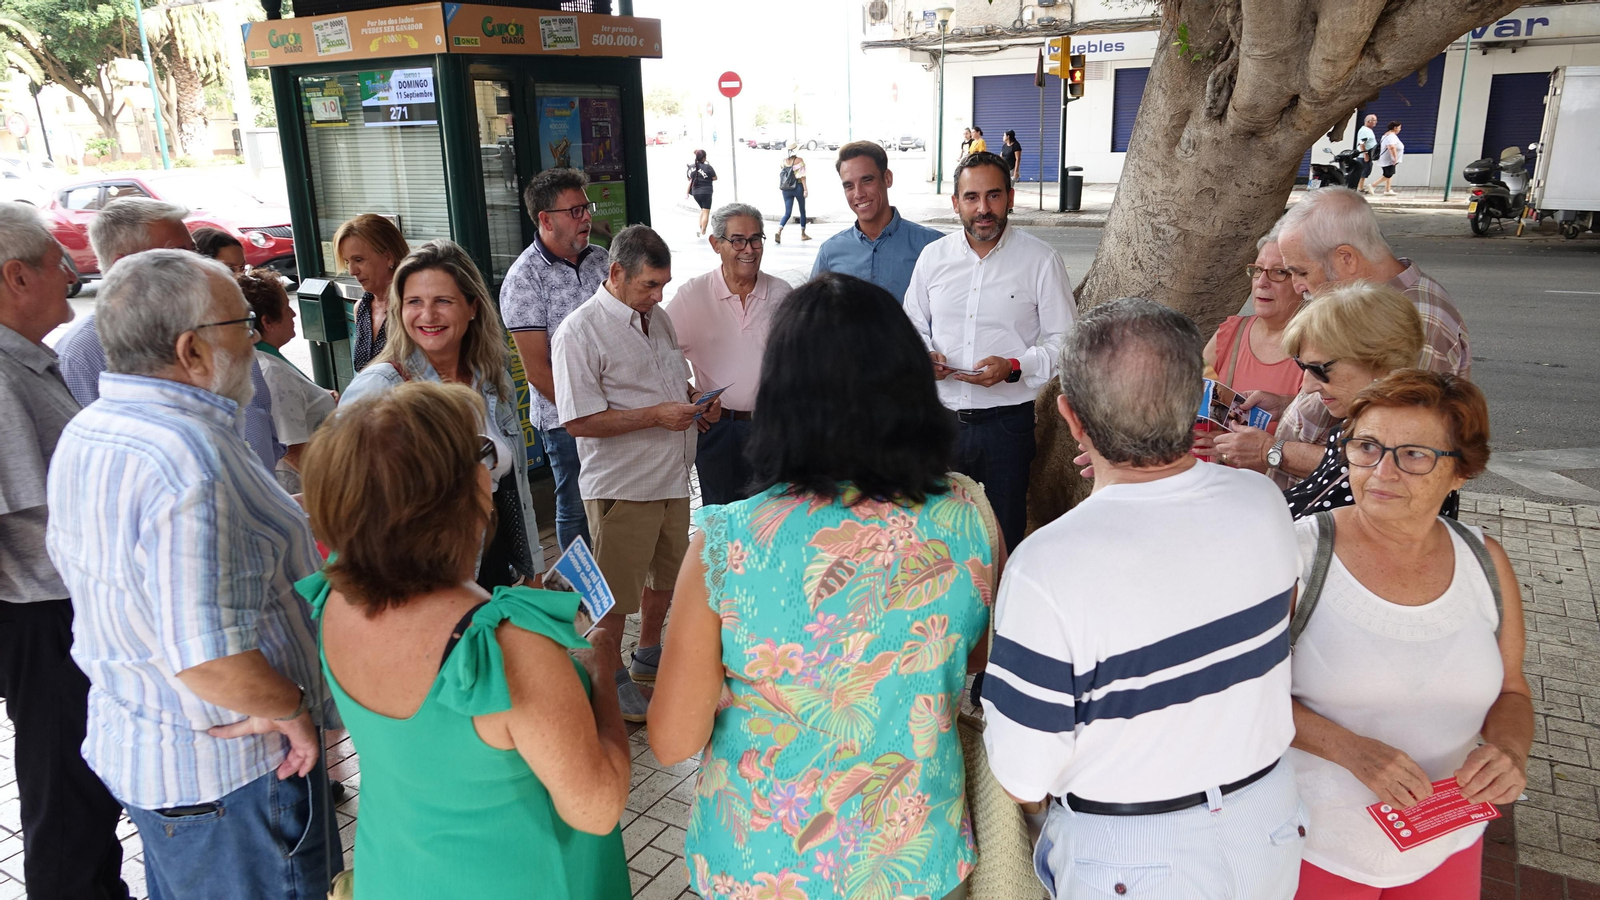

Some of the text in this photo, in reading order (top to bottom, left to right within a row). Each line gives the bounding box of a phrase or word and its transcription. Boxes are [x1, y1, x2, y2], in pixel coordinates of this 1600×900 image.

[398, 16, 415, 24] lados
[361, 23, 423, 35] PUEDES SER GANADOR
[612, 26, 634, 34] premio
[592, 33, 637, 47] 500.000
[398, 79, 429, 90] DOMINGO
[403, 90, 433, 100] Septiembre
[389, 106, 408, 120] 271
[573, 542, 609, 608] Quiero mi barrio
[567, 550, 603, 616] como calle Larios
